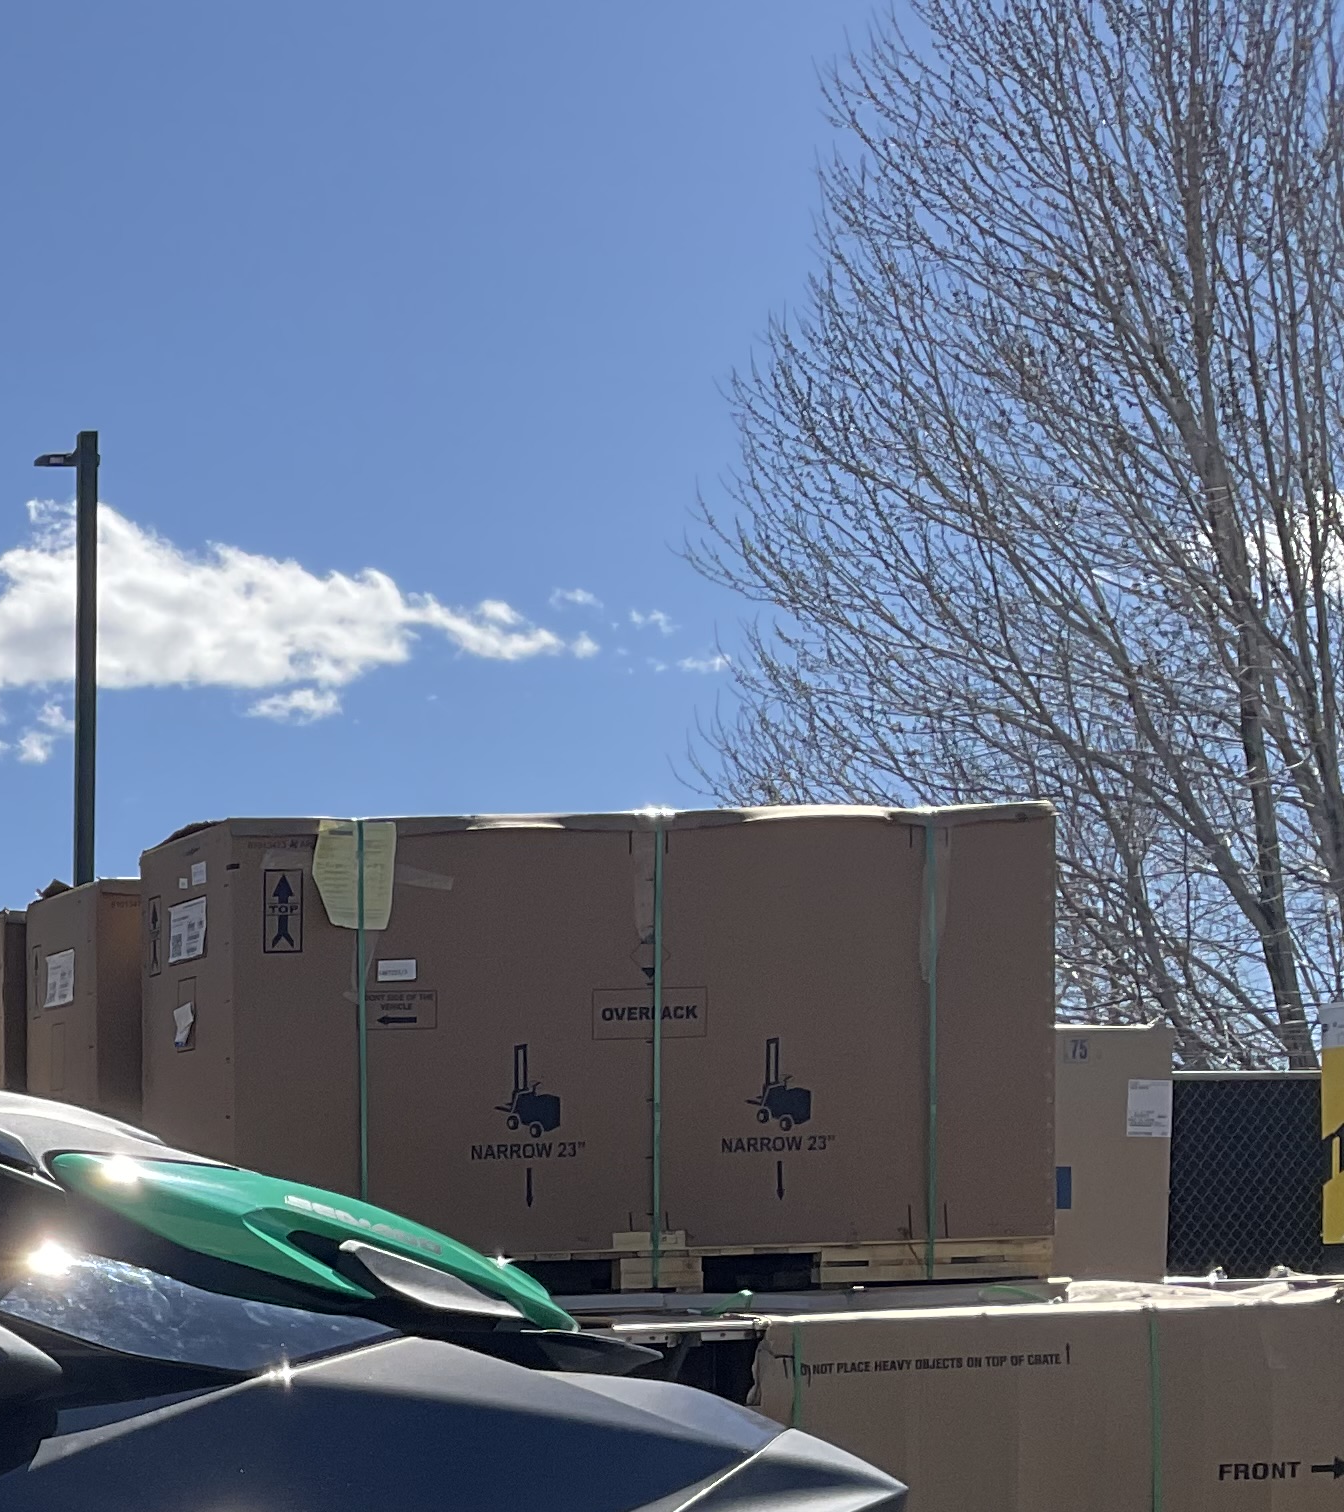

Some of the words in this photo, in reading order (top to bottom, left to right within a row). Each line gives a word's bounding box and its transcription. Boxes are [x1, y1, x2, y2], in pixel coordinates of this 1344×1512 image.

[1071, 1039, 1088, 1060] 75
[471, 1142, 553, 1160] NARROW
[721, 1136, 803, 1153] NARROW
[813, 1363, 834, 1375] NOT
[837, 1361, 871, 1374] PLACE
[874, 1359, 911, 1372] HEAVY
[915, 1357, 963, 1370] OBJECTS
[966, 1356, 982, 1368] ON
[985, 1355, 1007, 1367] TOP
[1011, 1355, 1025, 1366] OF
[1027, 1353, 1062, 1366] CRATE
[1218, 1461, 1301, 1481] FRONT
